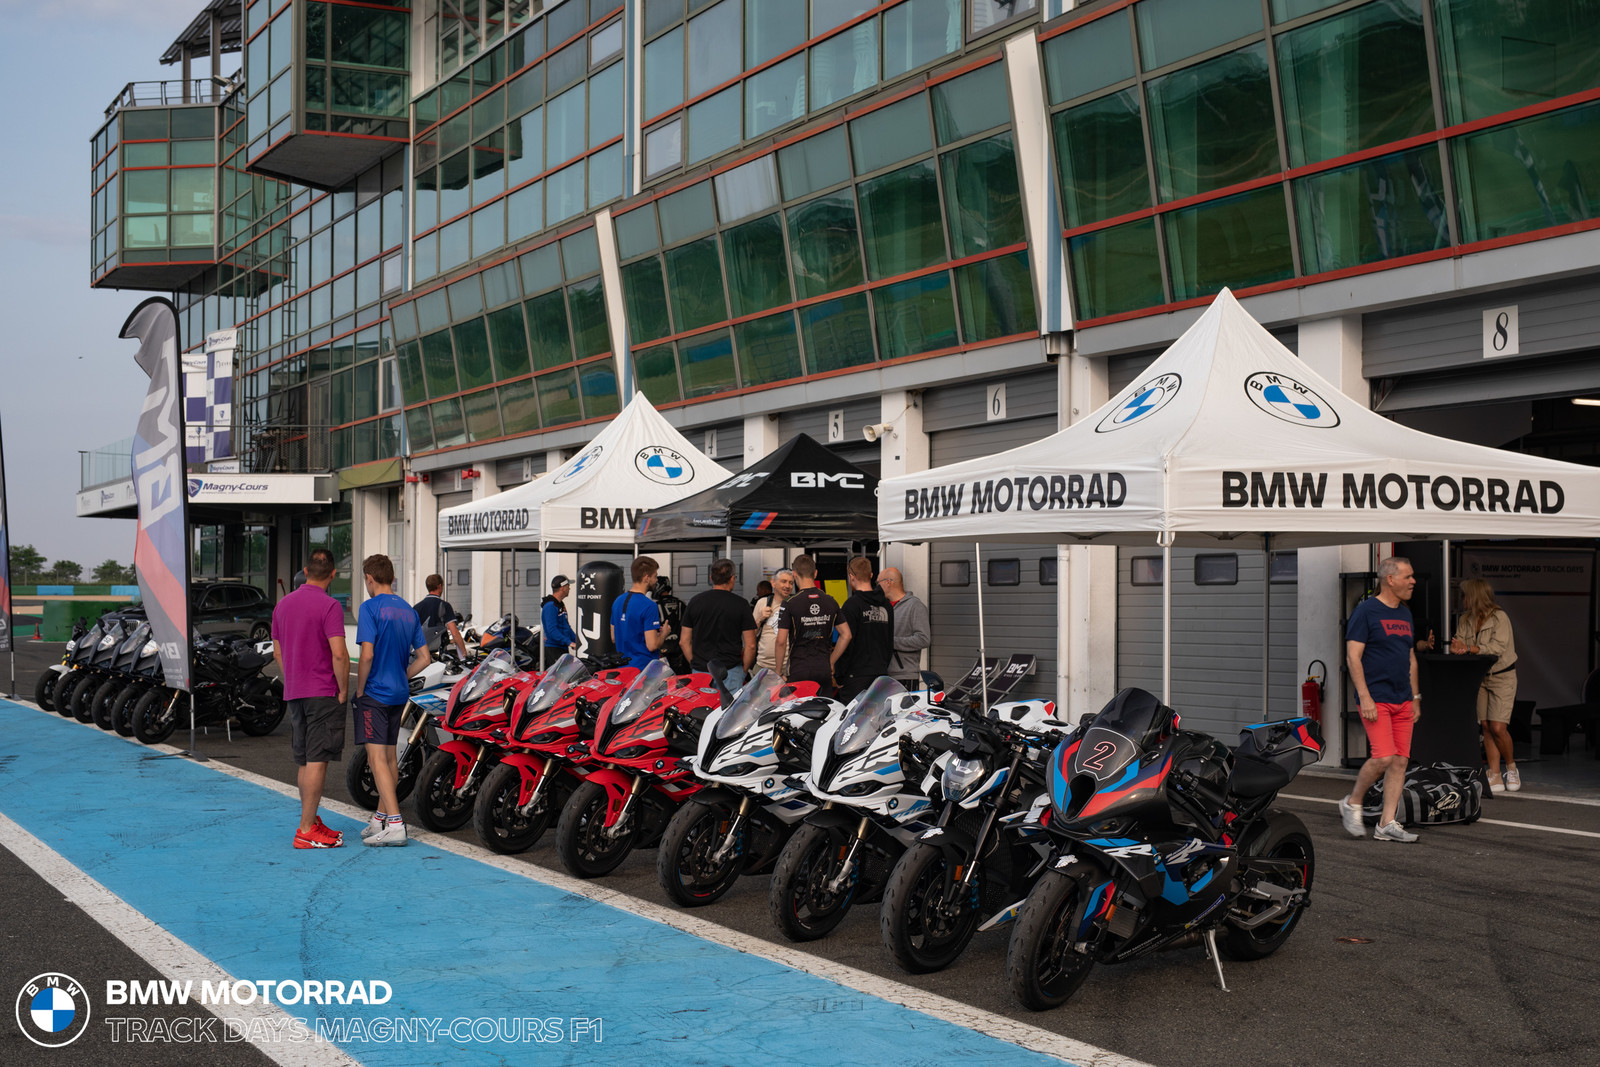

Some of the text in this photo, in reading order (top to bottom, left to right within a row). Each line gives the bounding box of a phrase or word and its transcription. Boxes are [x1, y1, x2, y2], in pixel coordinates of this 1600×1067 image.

[1492, 311, 1509, 352] 8
[992, 387, 1001, 417] 6
[832, 413, 840, 439] 5
[708, 432, 714, 455] 4
[203, 483, 268, 491] Magny-Cours
[790, 472, 865, 488] BMC
[1222, 471, 1565, 514] BMW MOTORRAD
[904, 472, 1127, 520] BMW MOTORRAD
[448, 508, 529, 535] BMW MOTORRAD
[1501, 564, 1541, 573] MOTORRAD
[1083, 741, 1117, 771] 2
